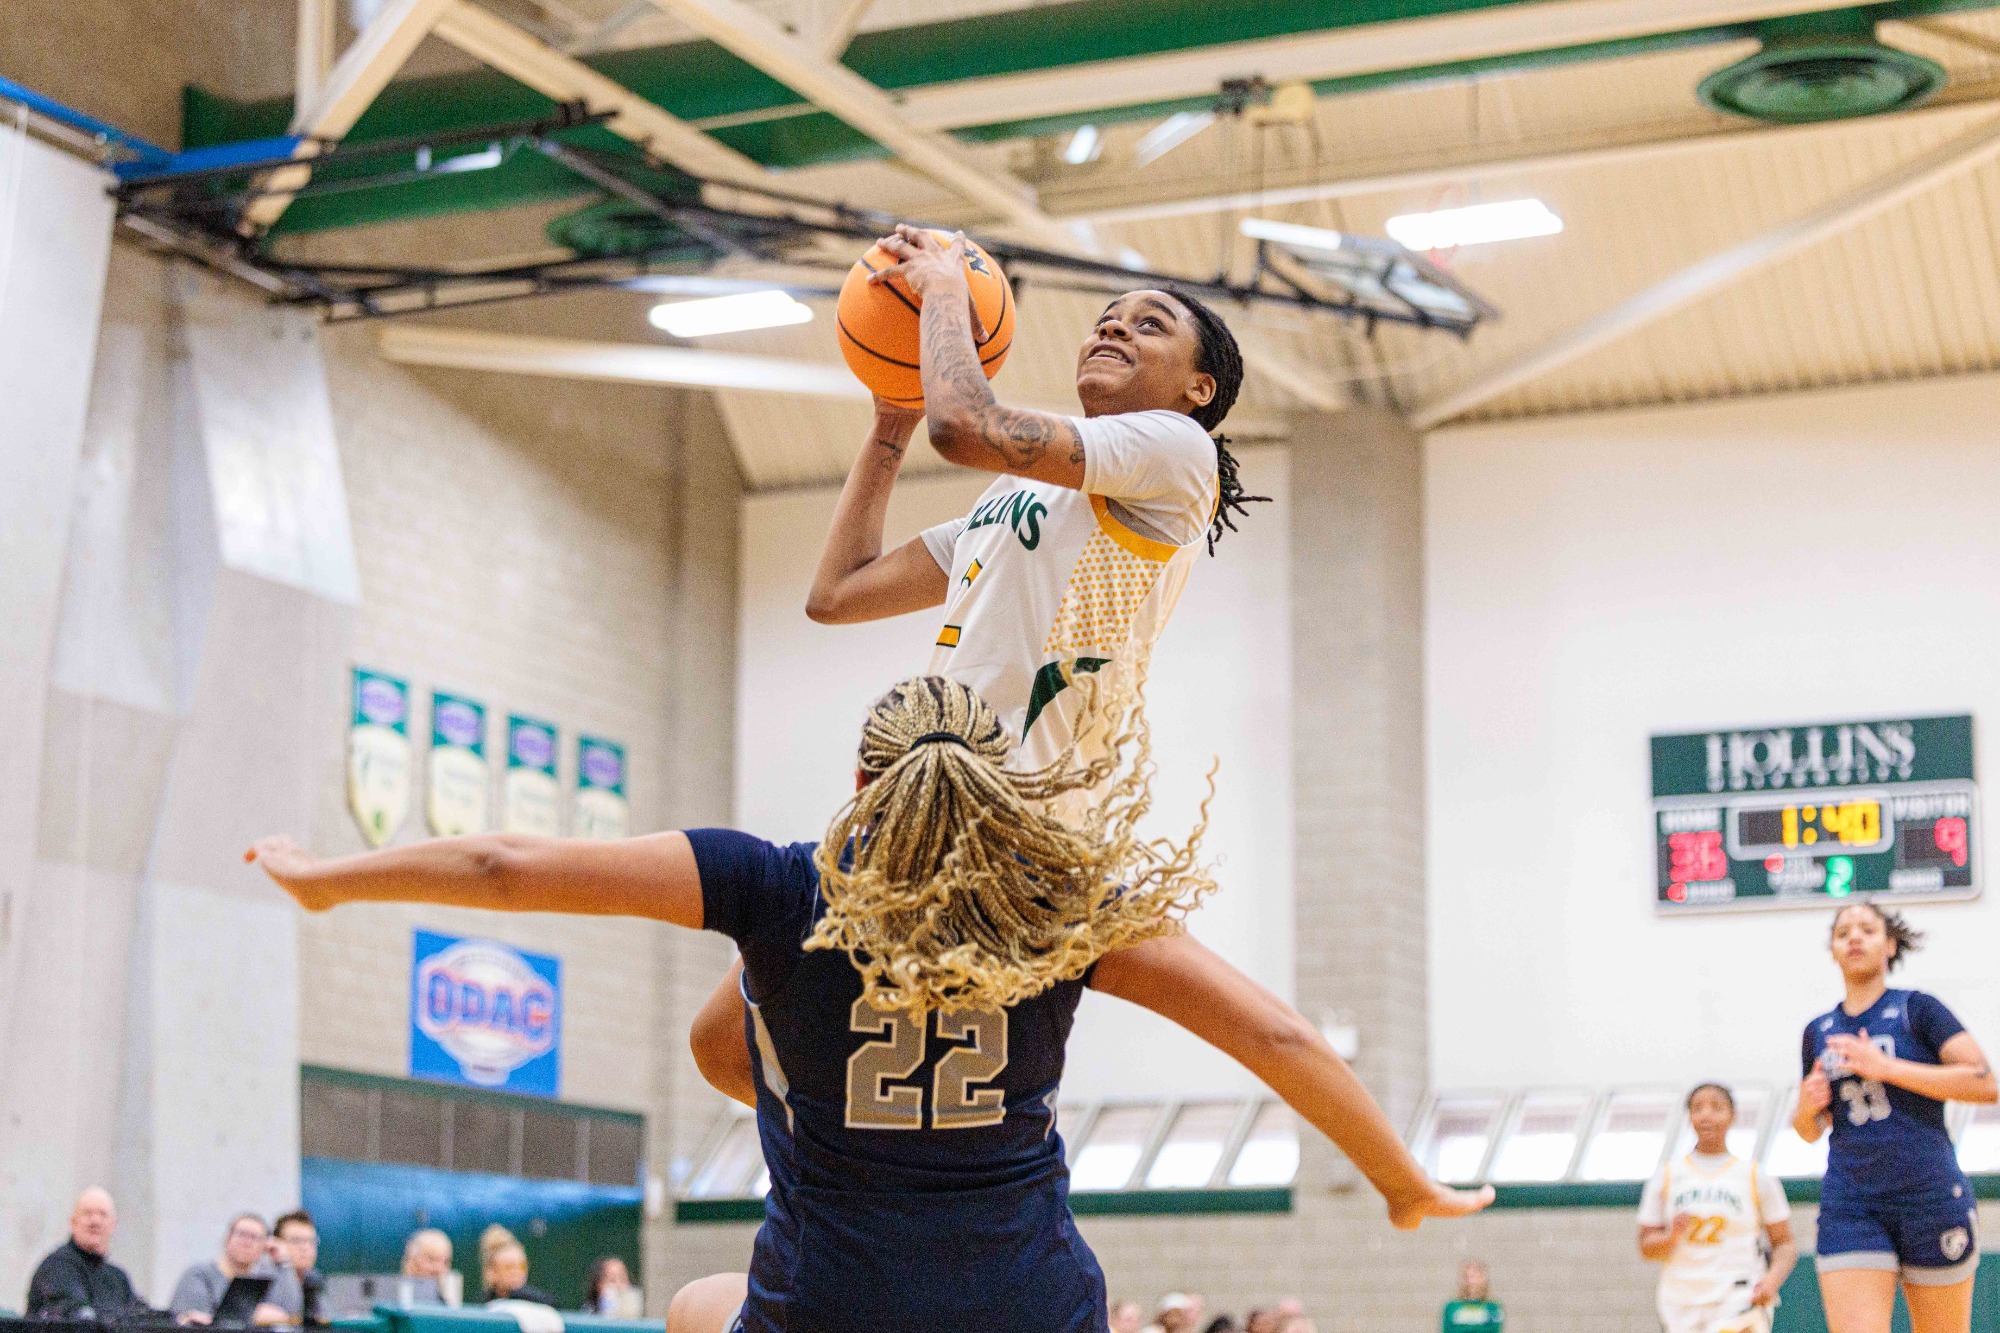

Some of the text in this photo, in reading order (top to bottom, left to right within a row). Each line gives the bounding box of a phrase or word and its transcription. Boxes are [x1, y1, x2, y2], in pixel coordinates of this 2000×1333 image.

[955, 489, 1048, 551] LLINS
[1704, 721, 1916, 775] HOLLINS
[1781, 798, 1881, 849] 1:40
[1934, 817, 1967, 866] 9
[1826, 855, 1853, 898] 2
[427, 972, 549, 1042] ODAC
[844, 996, 1009, 1129] 22
[1839, 1080, 1892, 1126] 33
[1687, 1215, 1726, 1246] 22
